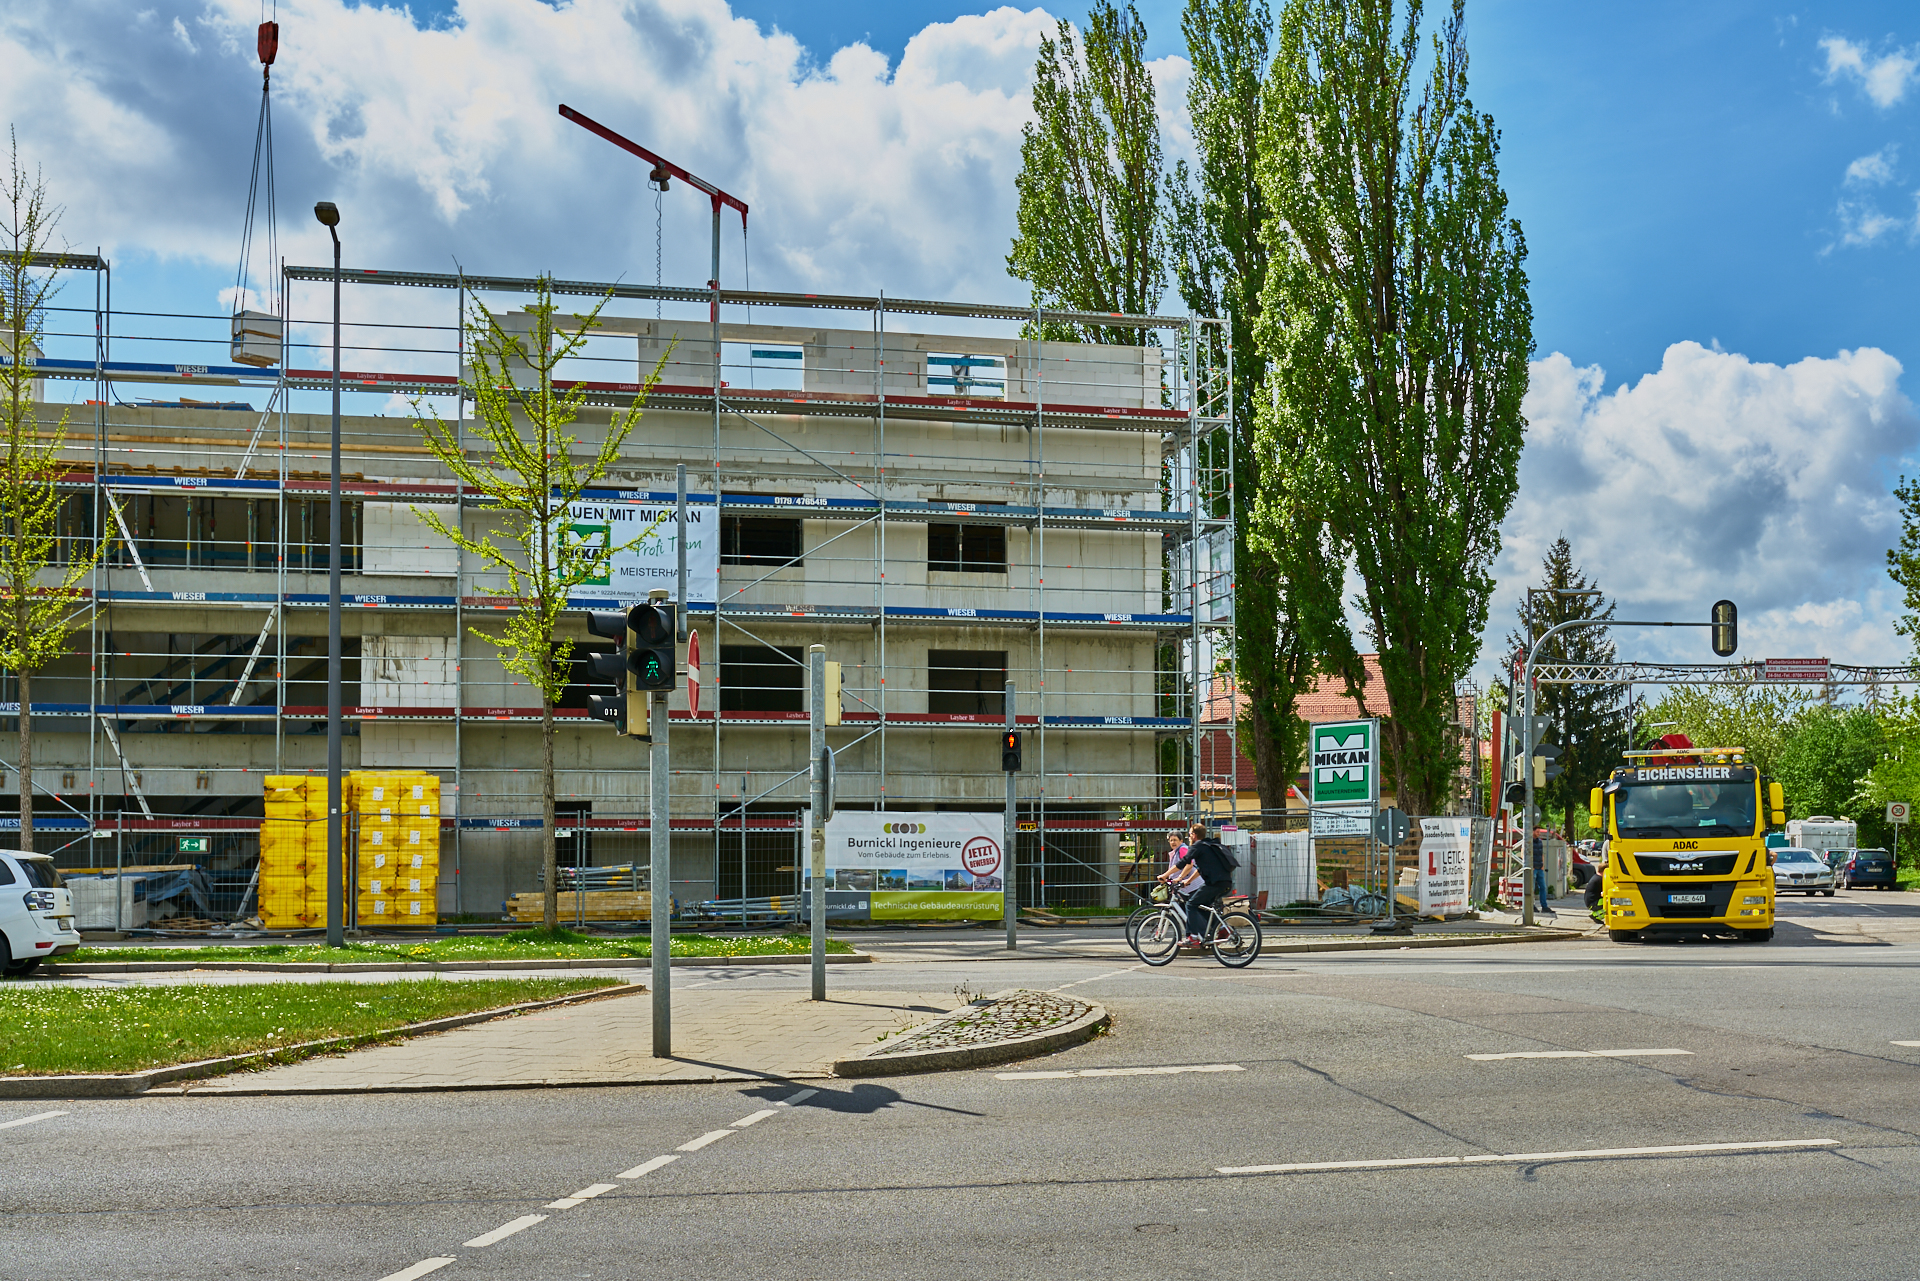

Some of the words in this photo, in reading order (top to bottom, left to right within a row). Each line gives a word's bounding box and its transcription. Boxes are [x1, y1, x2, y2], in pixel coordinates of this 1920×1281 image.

[2, 355, 37, 366] WISER
[174, 364, 208, 374] WIESER
[174, 477, 207, 486] WIESER
[618, 490, 650, 500] WIESER
[947, 502, 976, 512] WIESER
[609, 508, 635, 521] MIT
[1102, 509, 1131, 517] WIESER
[668, 536, 702, 552] Tam
[620, 567, 692, 578] MEISTERHAT
[172, 592, 206, 600] WIESER
[354, 594, 386, 603] WIESER
[786, 604, 814, 612] WIESER
[948, 608, 976, 616] WIESER
[1104, 614, 1132, 622] WIESER
[170, 705, 204, 714] WIESER
[604, 708, 618, 716] 013
[1314, 751, 1370, 766] MICKAN
[1638, 767, 1730, 781] EICHENSEHER
[0, 818, 20, 827] WIES
[489, 819, 520, 827] WIESER
[848, 838, 896, 848] Burnickl
[900, 838, 962, 851] Ingenieure
[1673, 841, 1698, 850] ADAC
[968, 845, 993, 859] JETZT
[970, 857, 996, 868] BEWERBEN
[1443, 851, 1465, 864] LETICA
[874, 901, 918, 909] Technische
[920, 902, 999, 911] Gebäudeausrüstung
